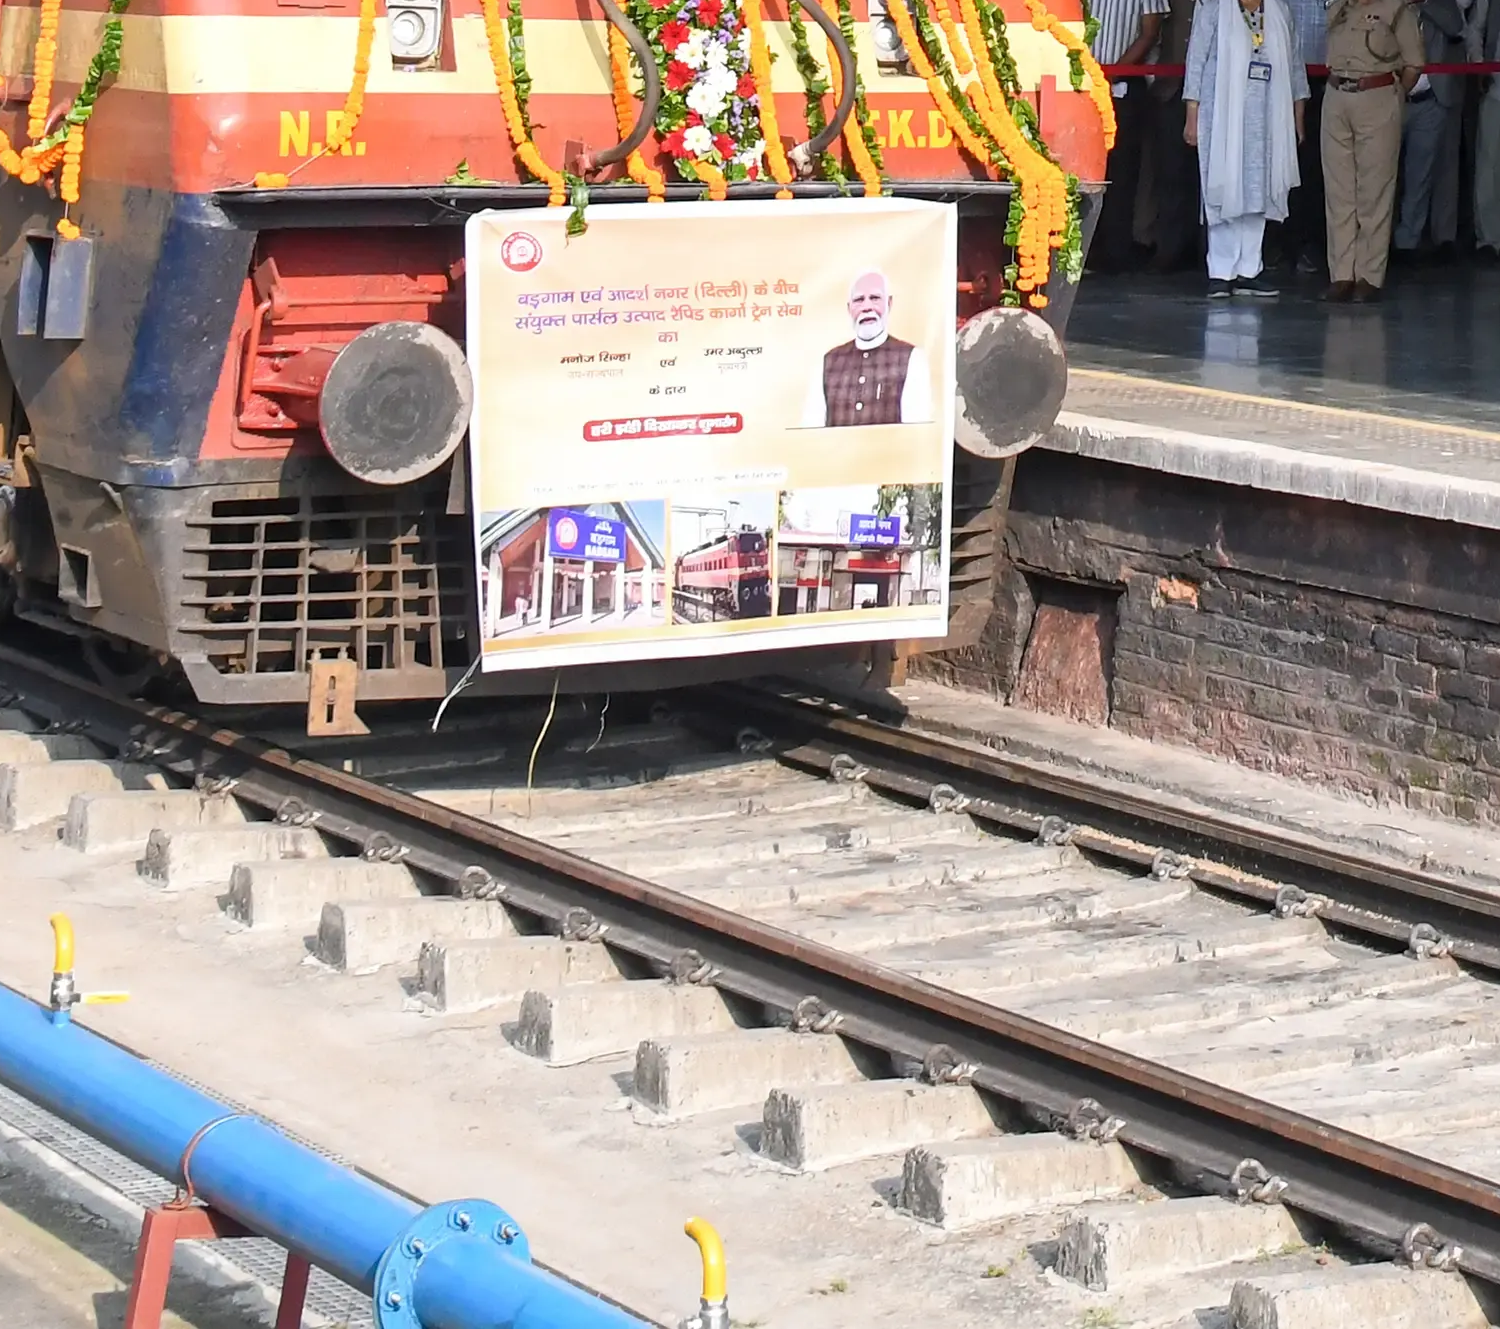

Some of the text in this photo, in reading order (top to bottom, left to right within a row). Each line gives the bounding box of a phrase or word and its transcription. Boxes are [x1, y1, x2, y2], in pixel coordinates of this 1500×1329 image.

[279, 110, 367, 157] N.R.
[580, 286, 605, 303] एवं
[607, 284, 650, 302] आदर्श
[653, 287, 689, 300] नगर
[694, 280, 748, 302] (दिल्ली)
[752, 281, 768, 297] के
[515, 301, 803, 335] संयुक्त पार्सल उत्पाद रैपिड कार्गो ट्रेन सेवा
[657, 330, 679, 344] का
[659, 356, 678, 368] एवं
